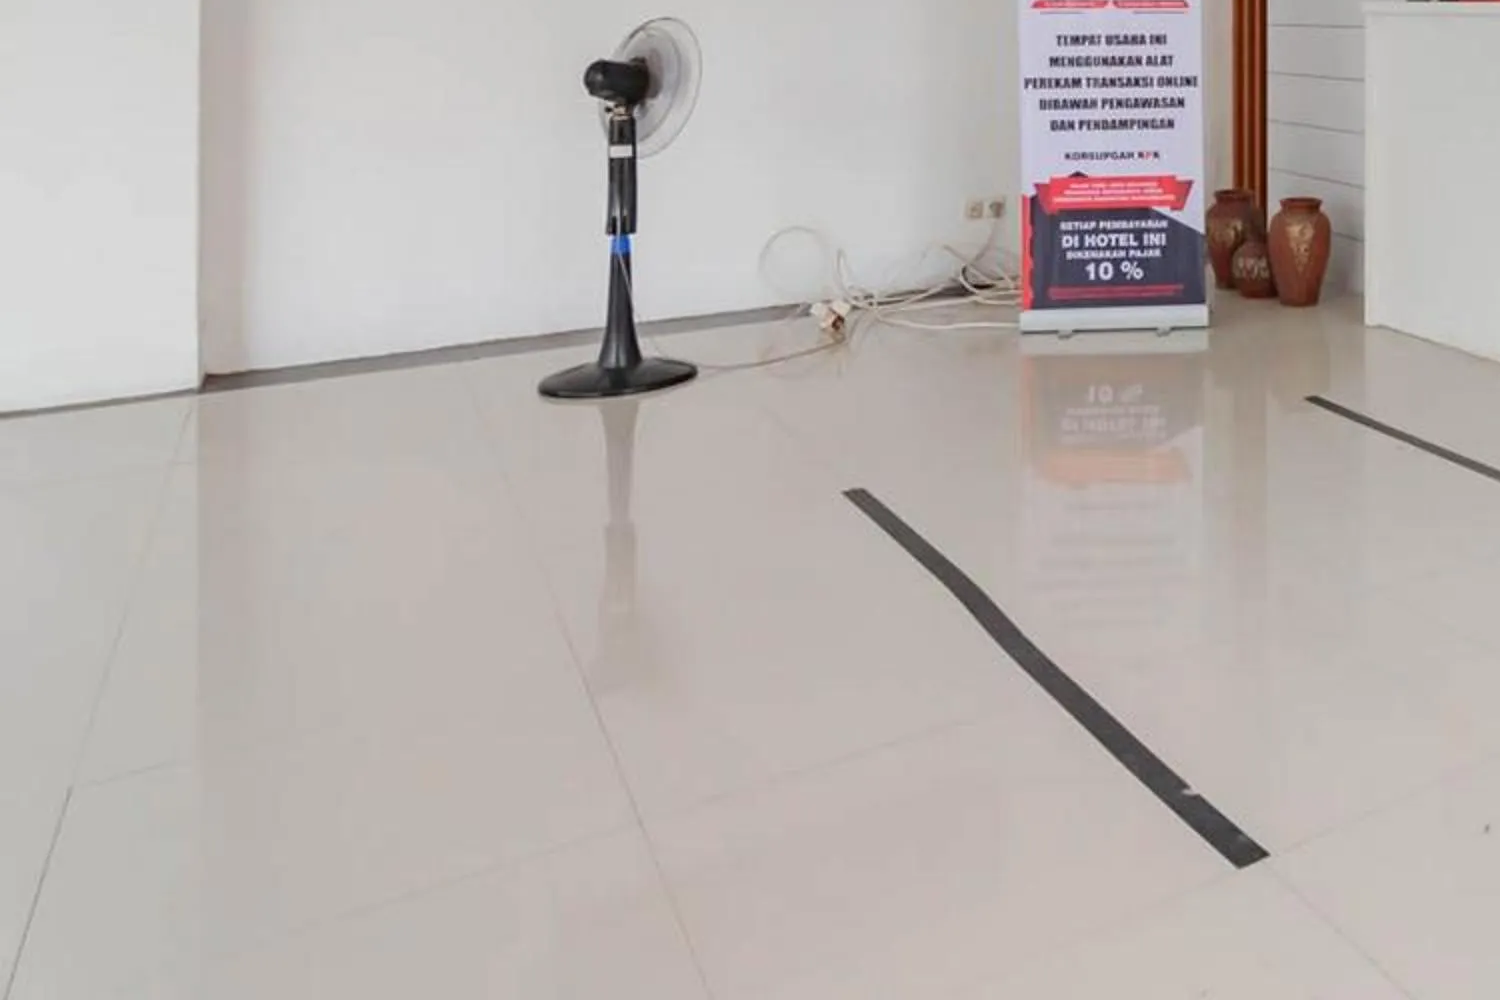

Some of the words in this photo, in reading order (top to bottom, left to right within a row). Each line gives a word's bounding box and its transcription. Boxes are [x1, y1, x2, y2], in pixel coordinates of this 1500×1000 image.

[1056, 34, 1102, 46] TEMPAT
[1105, 34, 1147, 45] USAHA
[1149, 33, 1167, 45] INI
[1049, 55, 1143, 67] MENGGUNAKAN
[1145, 55, 1174, 67] ALAT
[1024, 77, 1082, 89] PEREKAM
[1085, 76, 1154, 88] TRANSAKSI
[1157, 75, 1198, 87] ONLINE
[1039, 98, 1098, 110] DIBAWAH
[1101, 97, 1185, 109] PENGAWASAN
[1050, 120, 1075, 131] DAN
[1078, 119, 1175, 131] PENDAMPINGAN
[1061, 235, 1079, 248] DI
[1084, 234, 1138, 247] HOTEL
[1143, 233, 1167, 246] INI
[1085, 262, 1114, 280] 10
[1120, 261, 1144, 280] %
